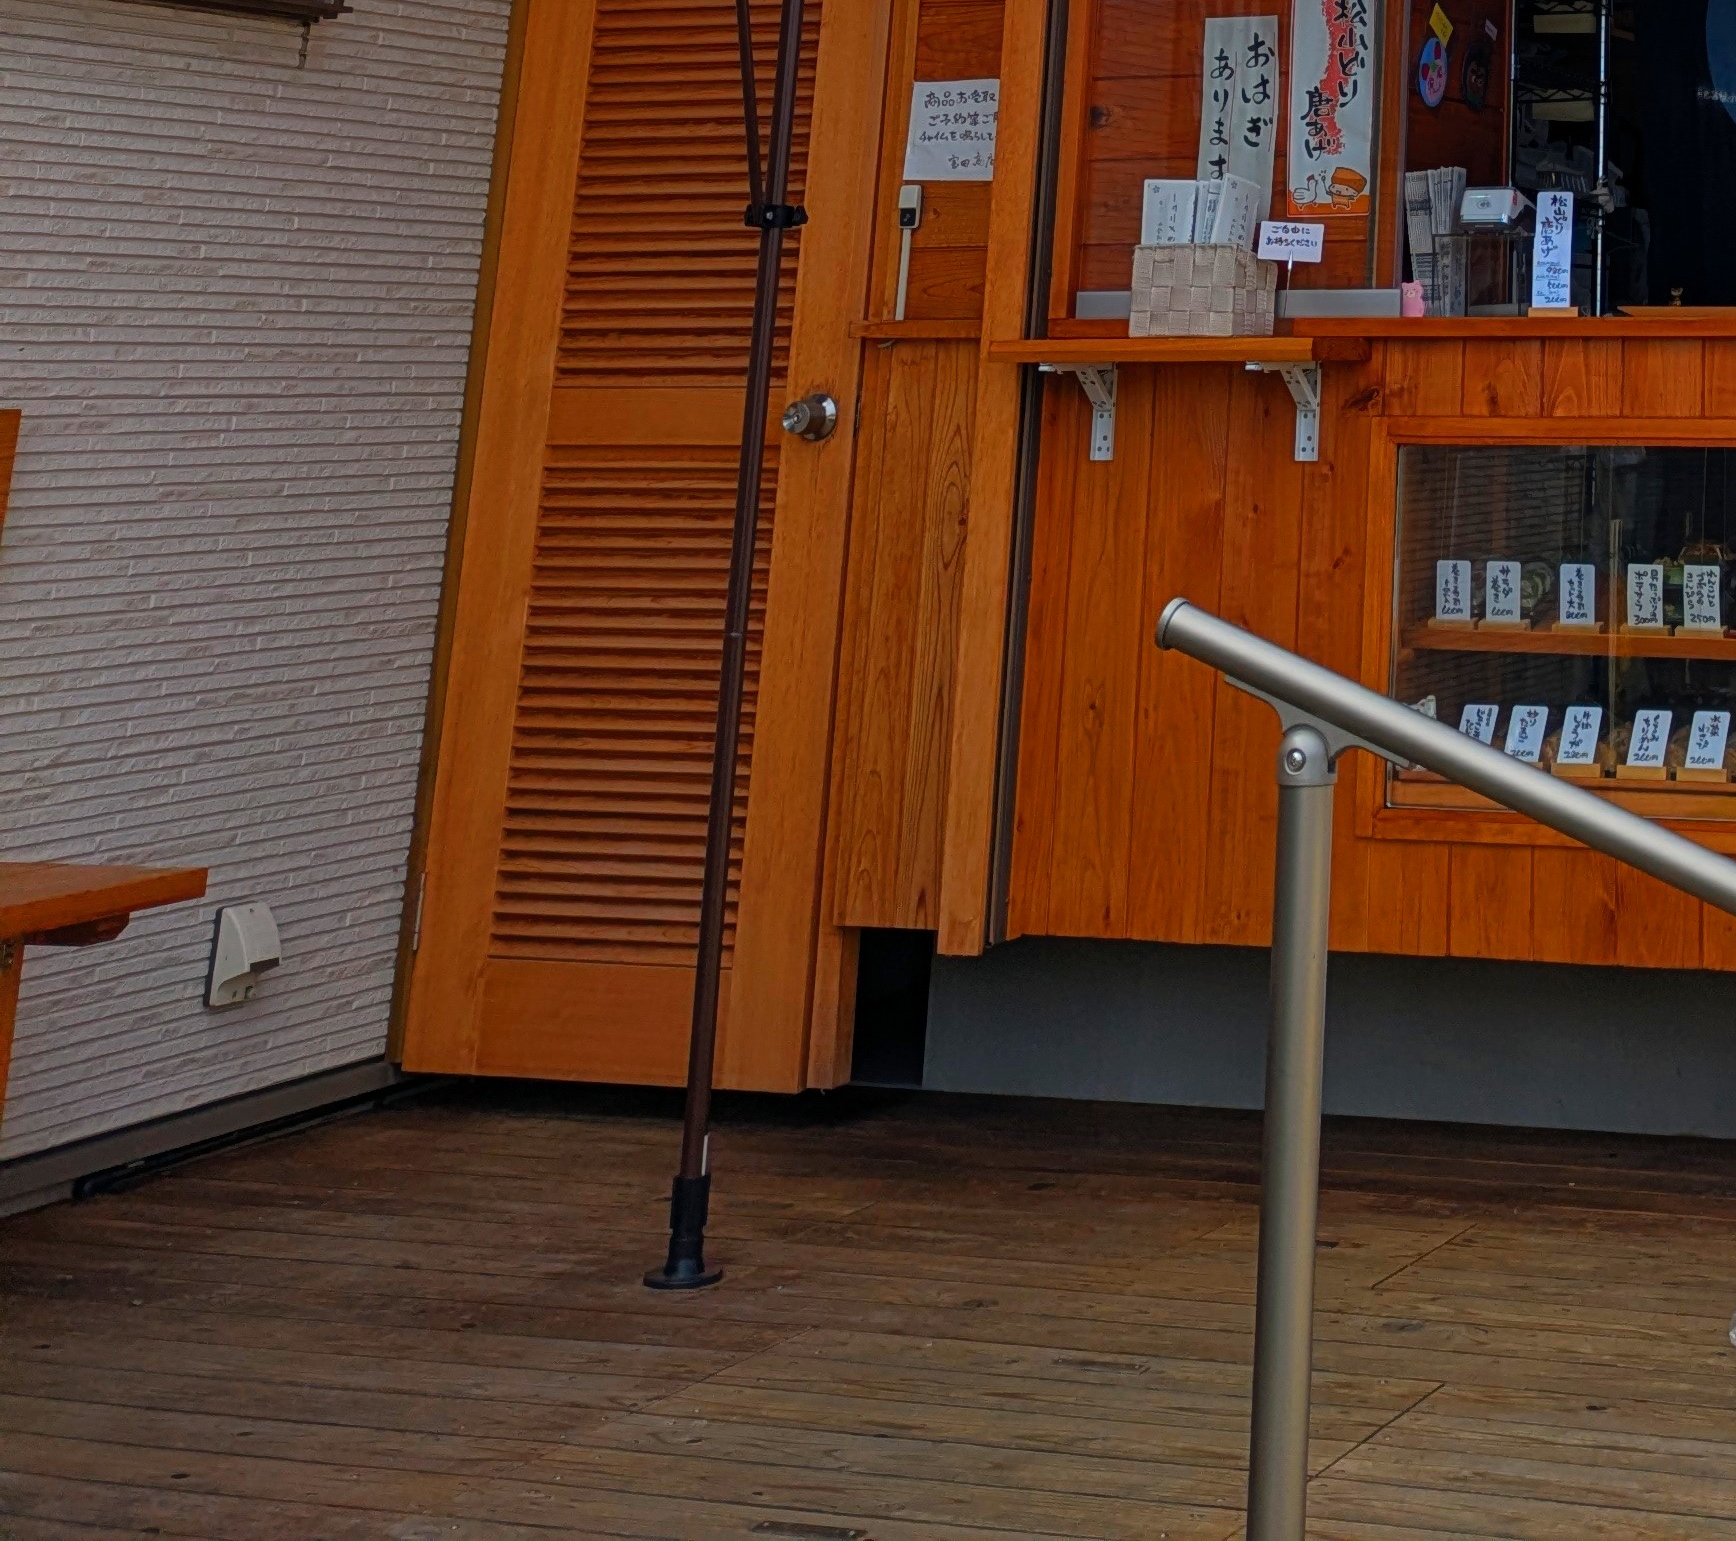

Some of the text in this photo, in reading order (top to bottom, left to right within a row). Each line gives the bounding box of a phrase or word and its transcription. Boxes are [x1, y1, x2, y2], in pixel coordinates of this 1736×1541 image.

[1207, 47, 1235, 180] あります
[1243, 33, 1276, 148] おはぎ
[1304, 86, 1337, 163] 唐あげ
